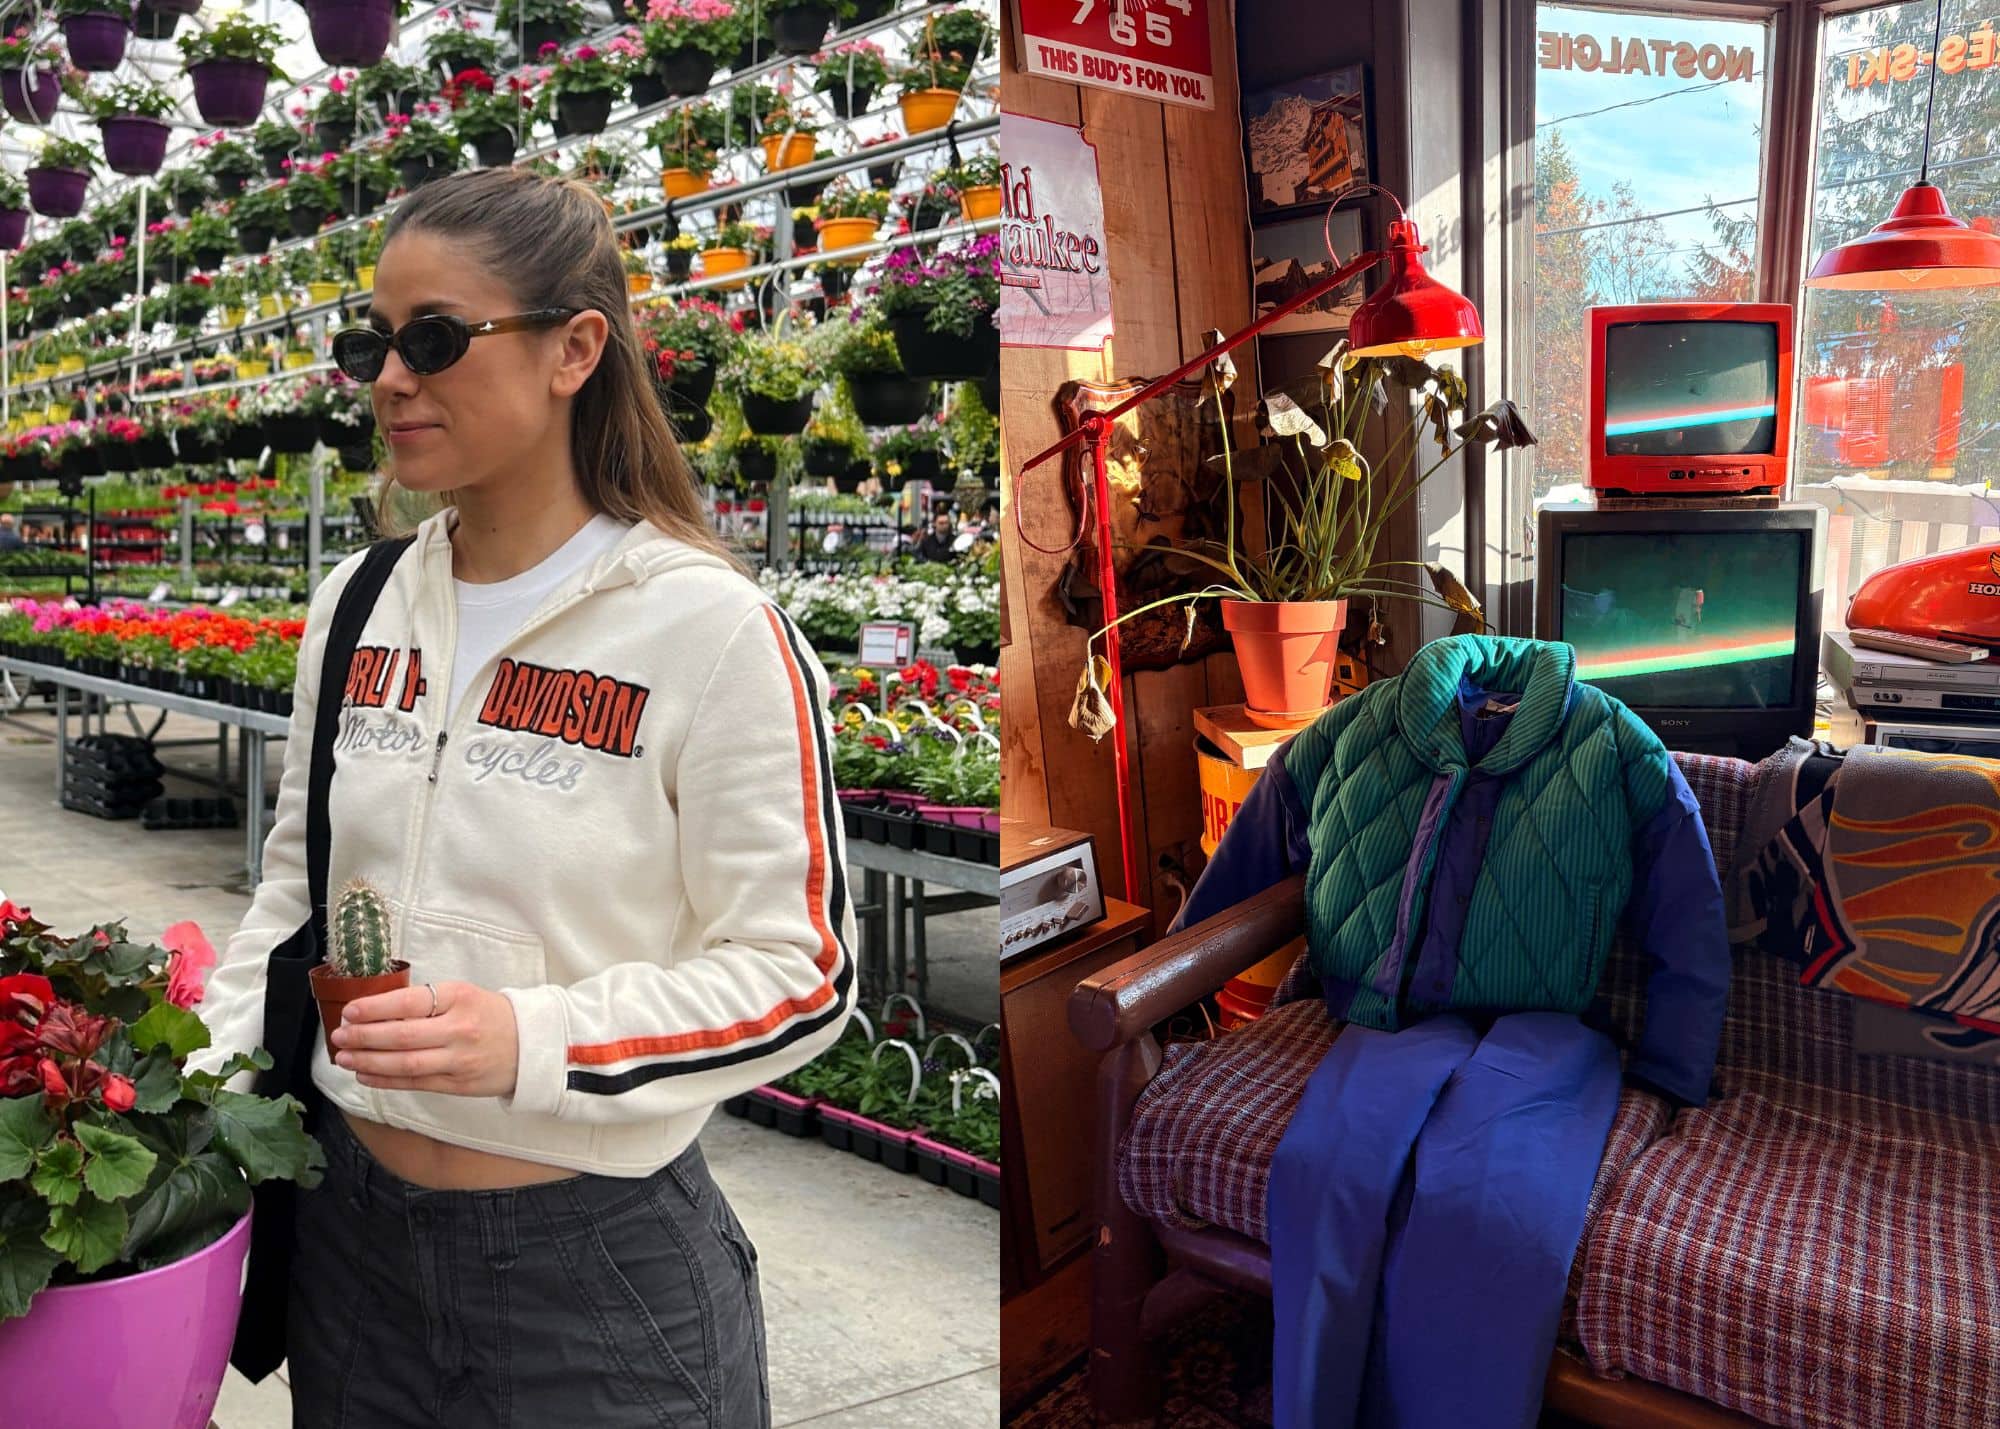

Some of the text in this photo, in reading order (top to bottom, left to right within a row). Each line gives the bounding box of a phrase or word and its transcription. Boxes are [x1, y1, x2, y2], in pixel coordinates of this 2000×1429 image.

[1108, 11, 1137, 47] 6
[1145, 10, 1173, 47] 5
[1038, 44, 1206, 101] THIS BUD'S FOR YOU.
[1000, 162, 1038, 225] ld
[477, 657, 650, 758] DAVIDSON
[1660, 719, 1690, 727] SONY
[335, 694, 586, 794] Motor cycles
[1202, 789, 1242, 843] PIR
